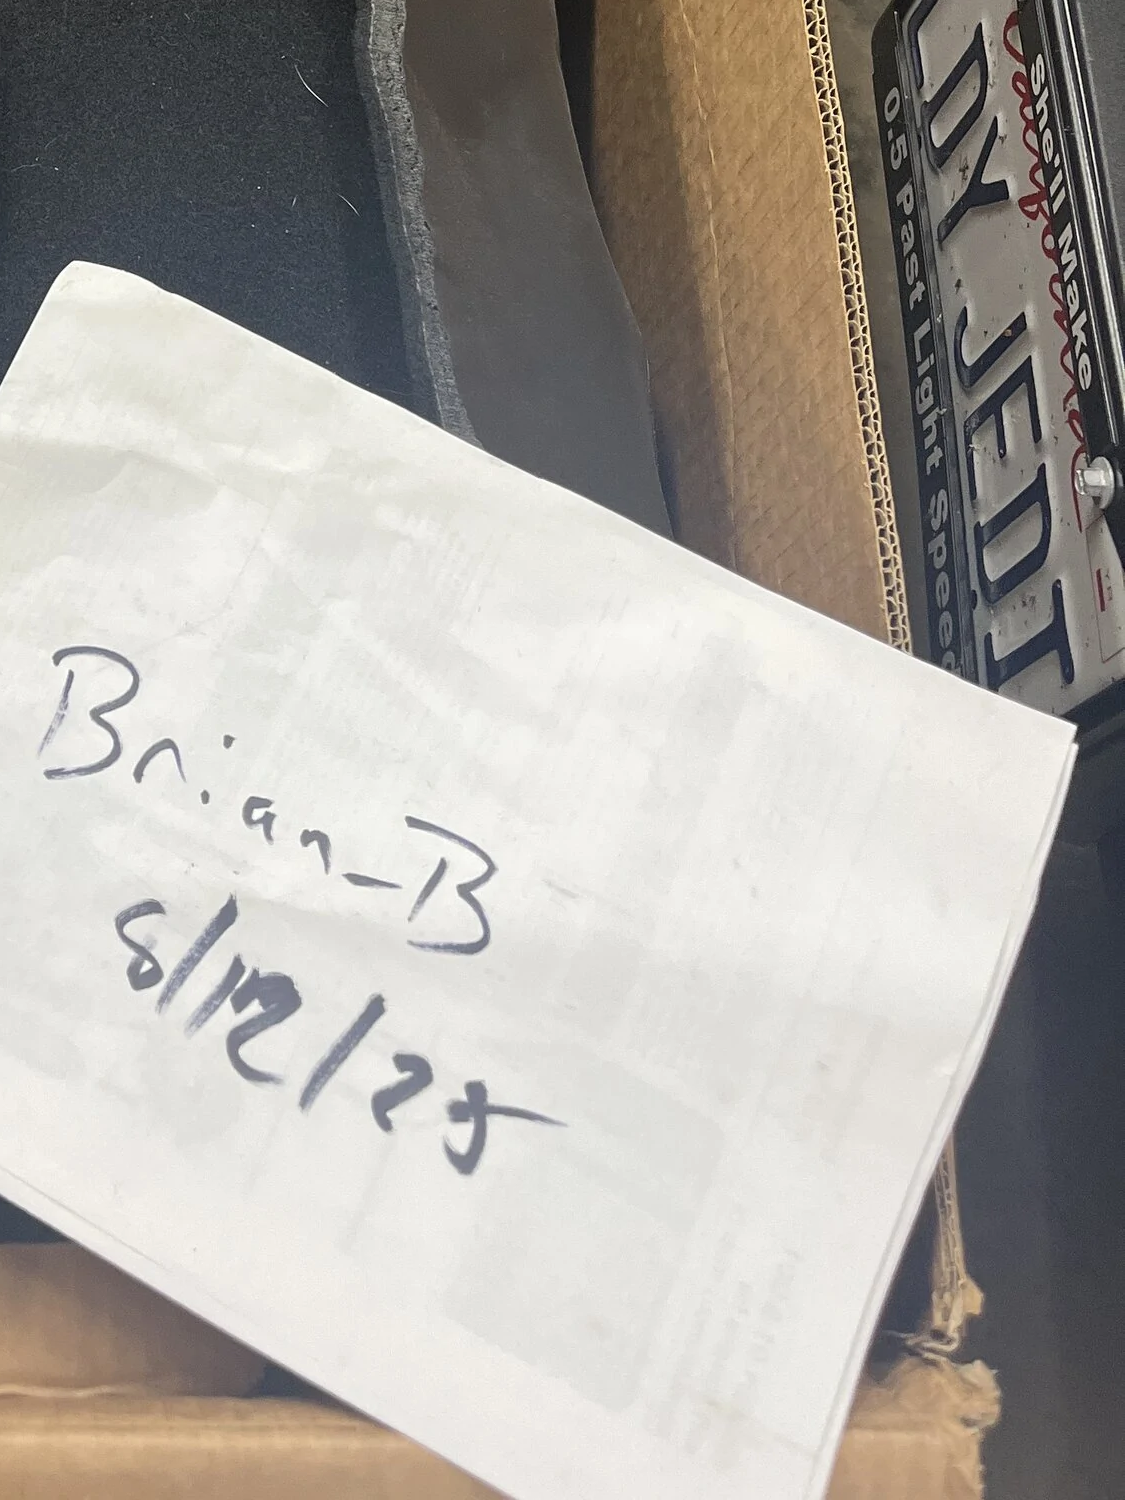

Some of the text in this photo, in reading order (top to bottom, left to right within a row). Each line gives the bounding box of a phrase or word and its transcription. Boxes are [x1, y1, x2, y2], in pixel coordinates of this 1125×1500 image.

[884, 86, 908, 170] 0.5
[896, 180, 925, 310] Past
[913, 318, 944, 476] Light
[1030, 53, 1092, 391] She'll Make
